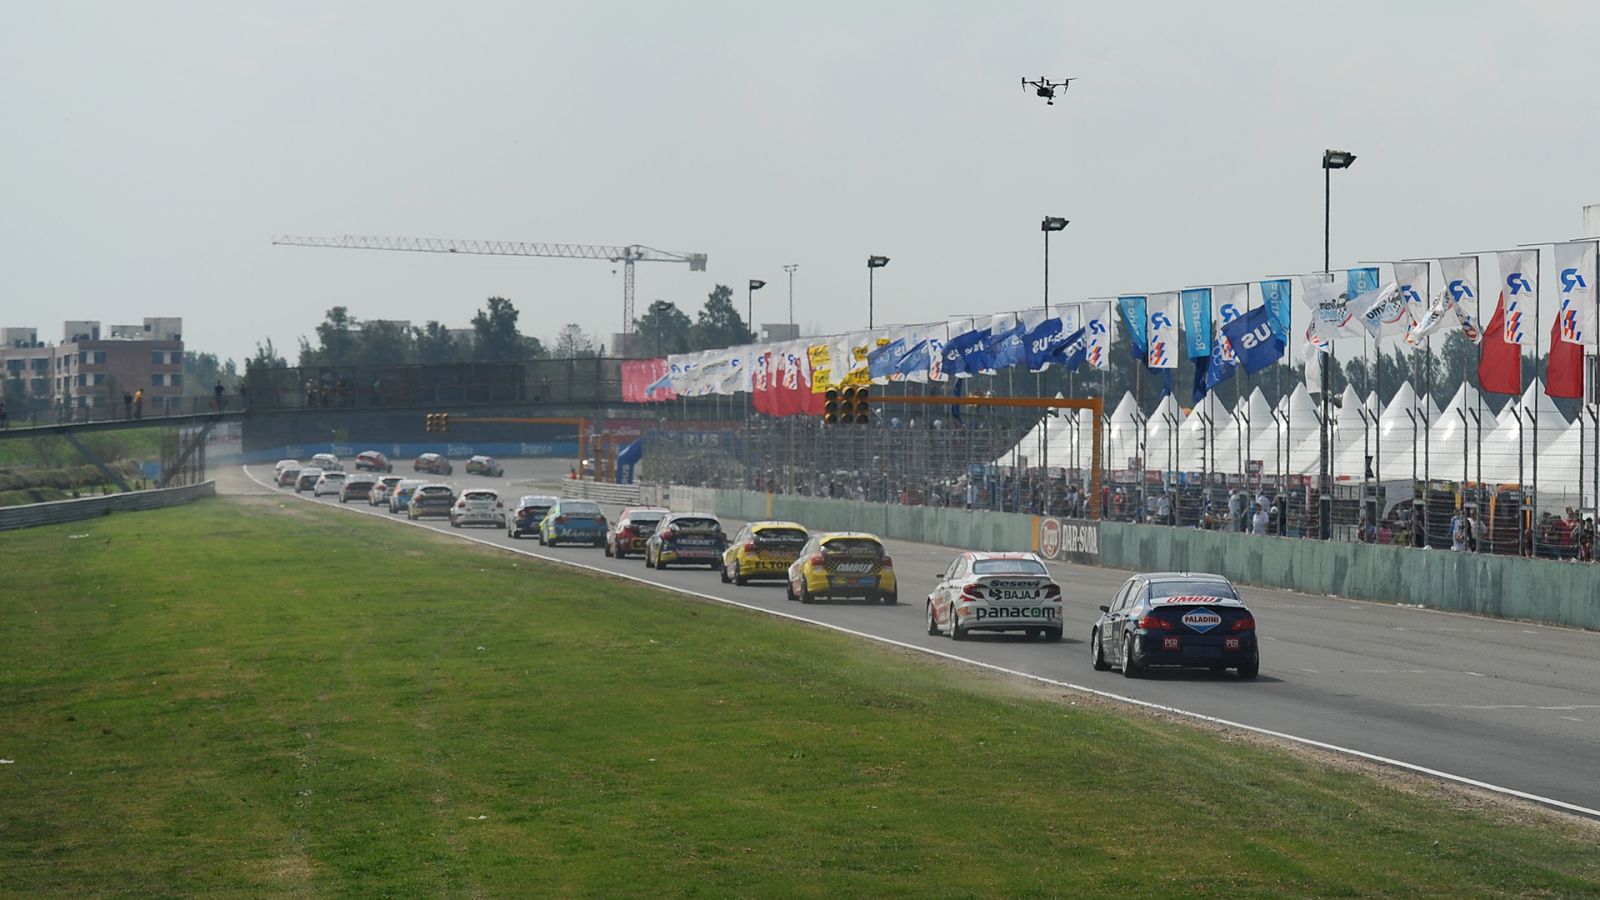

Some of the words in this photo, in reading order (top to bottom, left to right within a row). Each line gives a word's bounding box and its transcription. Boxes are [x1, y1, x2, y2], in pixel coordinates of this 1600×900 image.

[1004, 590, 1037, 600] BAJAJ
[976, 606, 1056, 621] panacom
[1184, 615, 1220, 624] PALADINI
